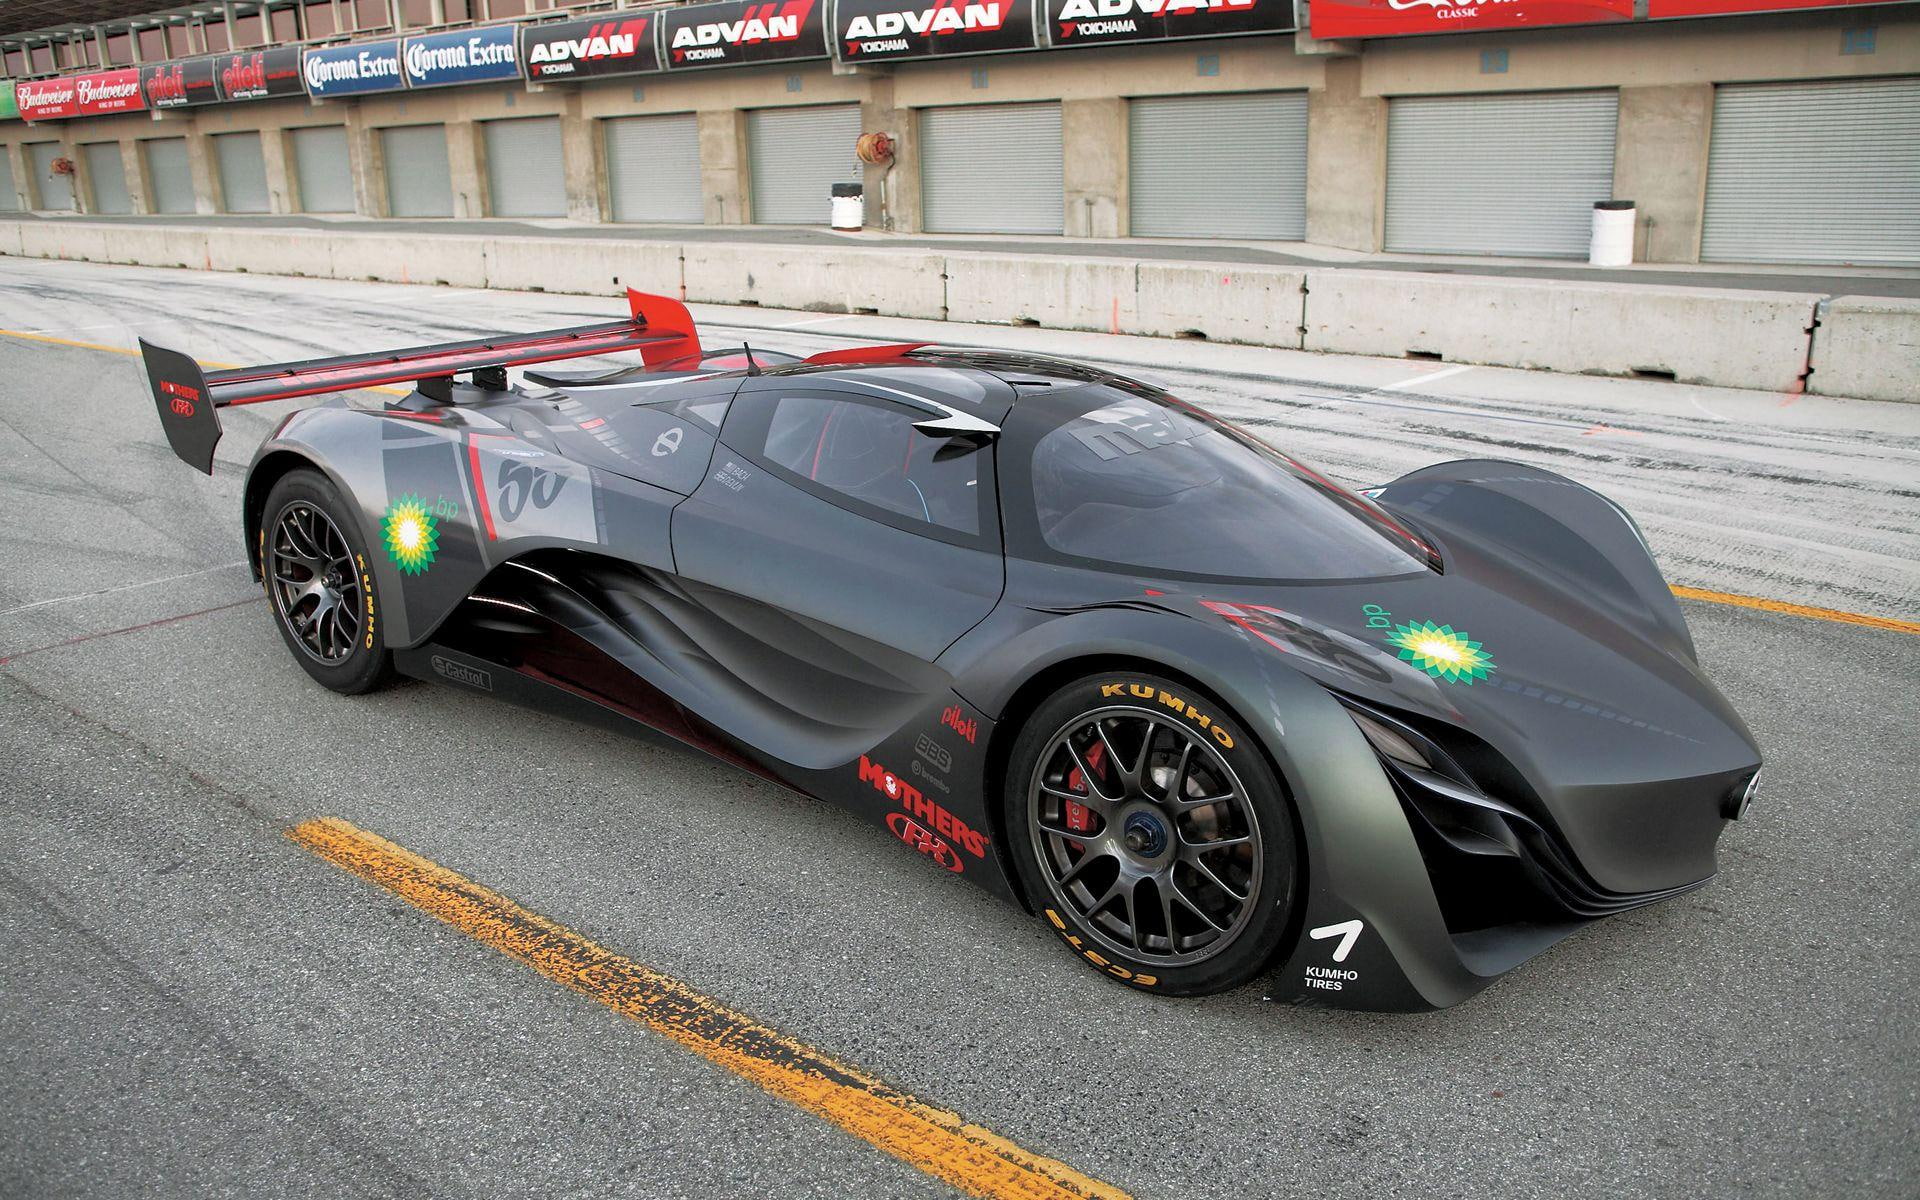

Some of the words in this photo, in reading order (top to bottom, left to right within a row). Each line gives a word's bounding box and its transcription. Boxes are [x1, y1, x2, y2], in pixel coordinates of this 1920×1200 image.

[845, 2, 1000, 40] ADVAN
[1436, 7, 1479, 19] CLASSIC
[671, 15, 798, 48] ADVAN
[1076, 20, 1137, 36] YOKOHAMA
[407, 43, 467, 81] Corona
[468, 37, 515, 66] Extra
[529, 34, 635, 64] ADVAN
[684, 47, 726, 61] YOKOHAMA
[860, 39, 910, 53] YOKOHAMA
[306, 56, 358, 90] Corona
[358, 52, 399, 78] Extra
[18, 85, 74, 110] Budweiser
[77, 79, 138, 104] Budweiser
[160, 381, 200, 402] MOTHERS
[436, 494, 458, 523] bp
[356, 553, 375, 649] KUMHO
[1362, 603, 1391, 628] bp
[445, 661, 486, 687] Castrol
[940, 704, 977, 744] piloti
[1101, 683, 1235, 749] KUMHO
[915, 734, 952, 773] BBS
[921, 766, 950, 794] brembo
[858, 753, 986, 859] MOTHERS
[1304, 977, 1343, 991] TIRES
[1305, 966, 1358, 981] KUMHO
